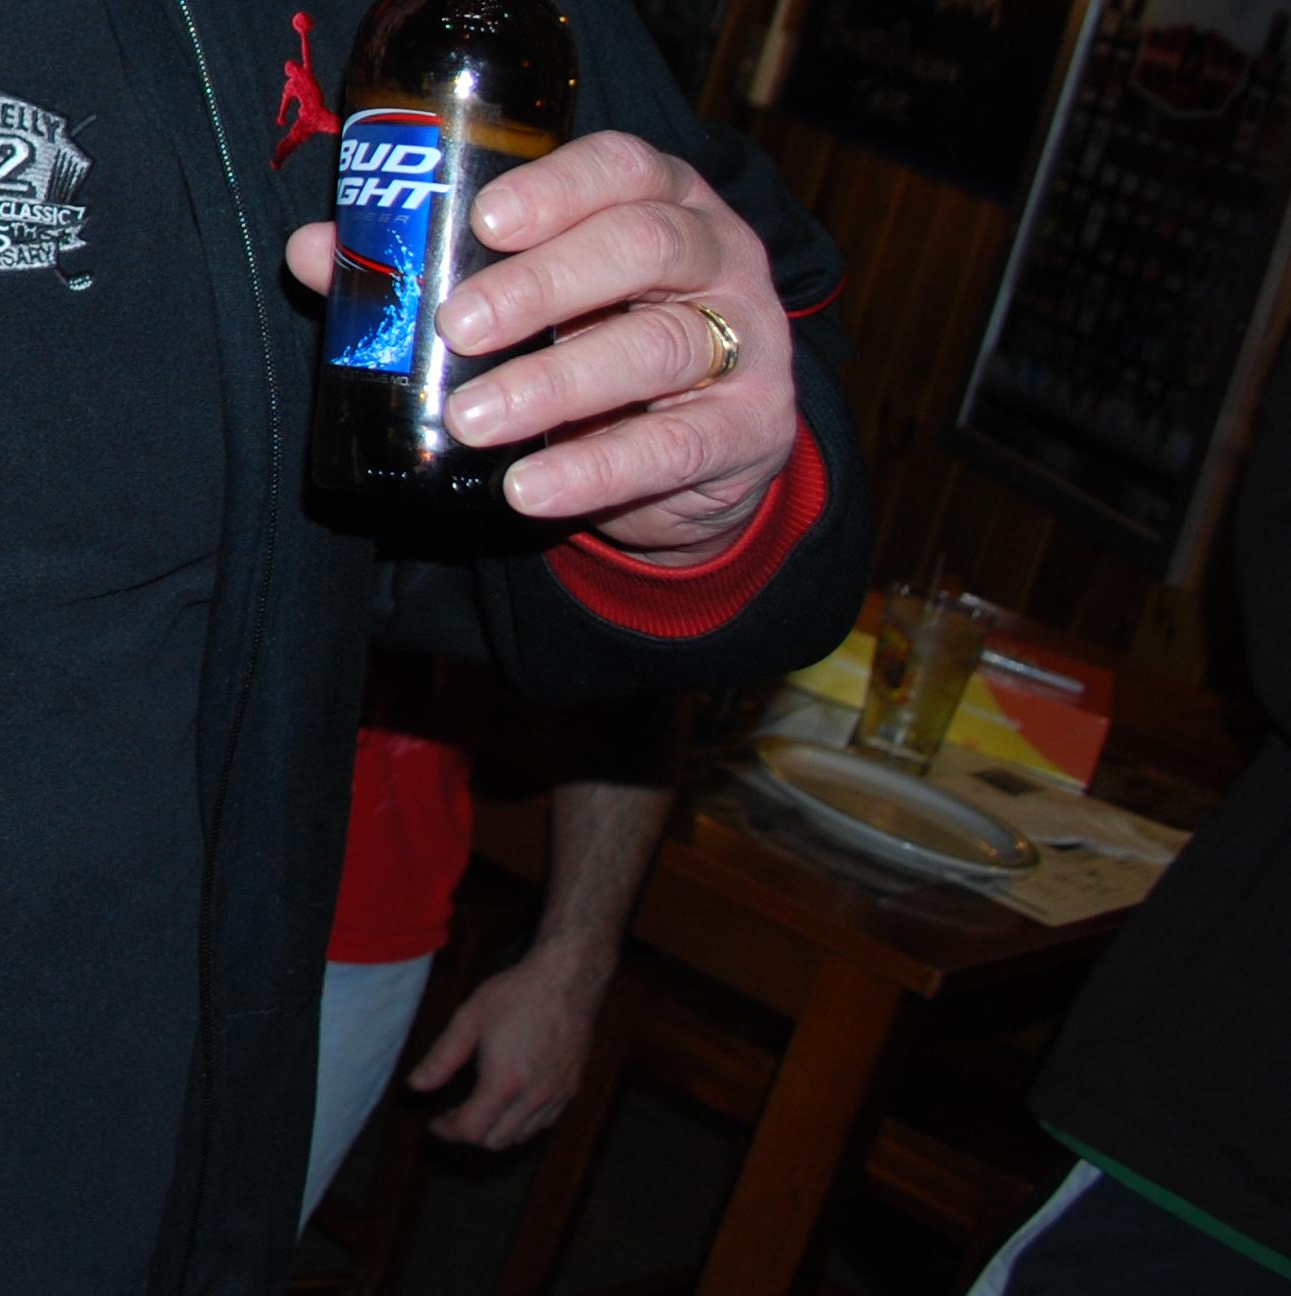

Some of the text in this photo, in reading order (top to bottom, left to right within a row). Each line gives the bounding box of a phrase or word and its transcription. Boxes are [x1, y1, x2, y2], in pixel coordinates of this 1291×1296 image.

[338, 138, 442, 174] BUD
[336, 176, 452, 210] GHT
[0, 201, 71, 225] CLASSIC
